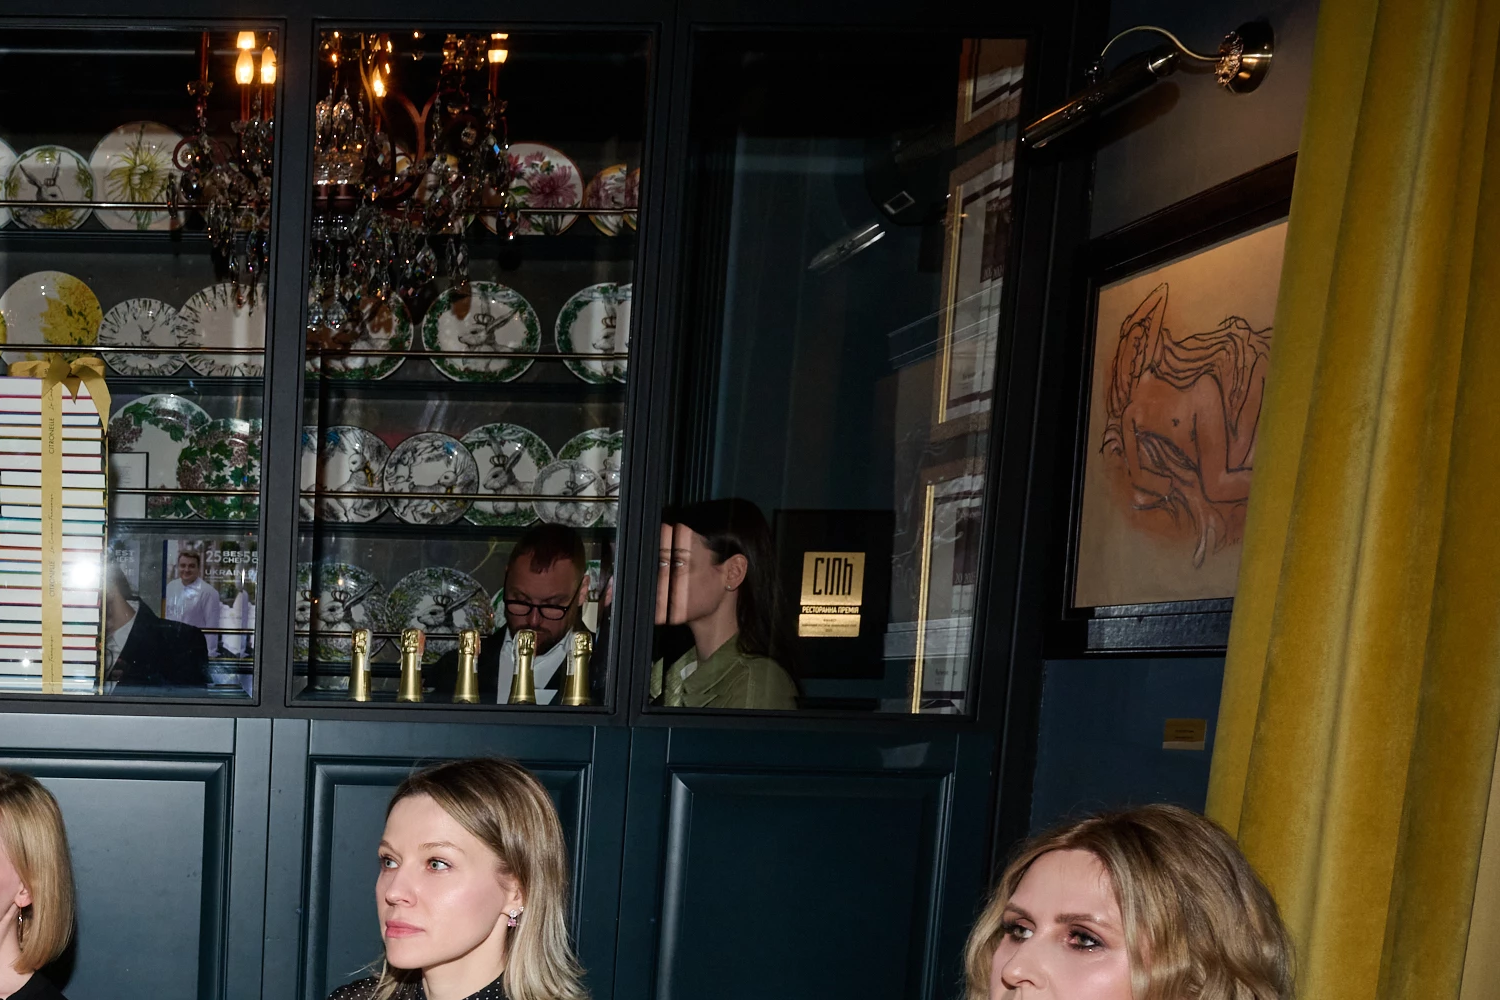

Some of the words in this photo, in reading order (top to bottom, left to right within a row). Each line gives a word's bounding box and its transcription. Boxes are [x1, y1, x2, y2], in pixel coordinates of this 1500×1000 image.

[206, 551, 221, 563] 25
[813, 557, 853, 595] СІЛЬ
[838, 606, 859, 614] ПРЕМІЯ
